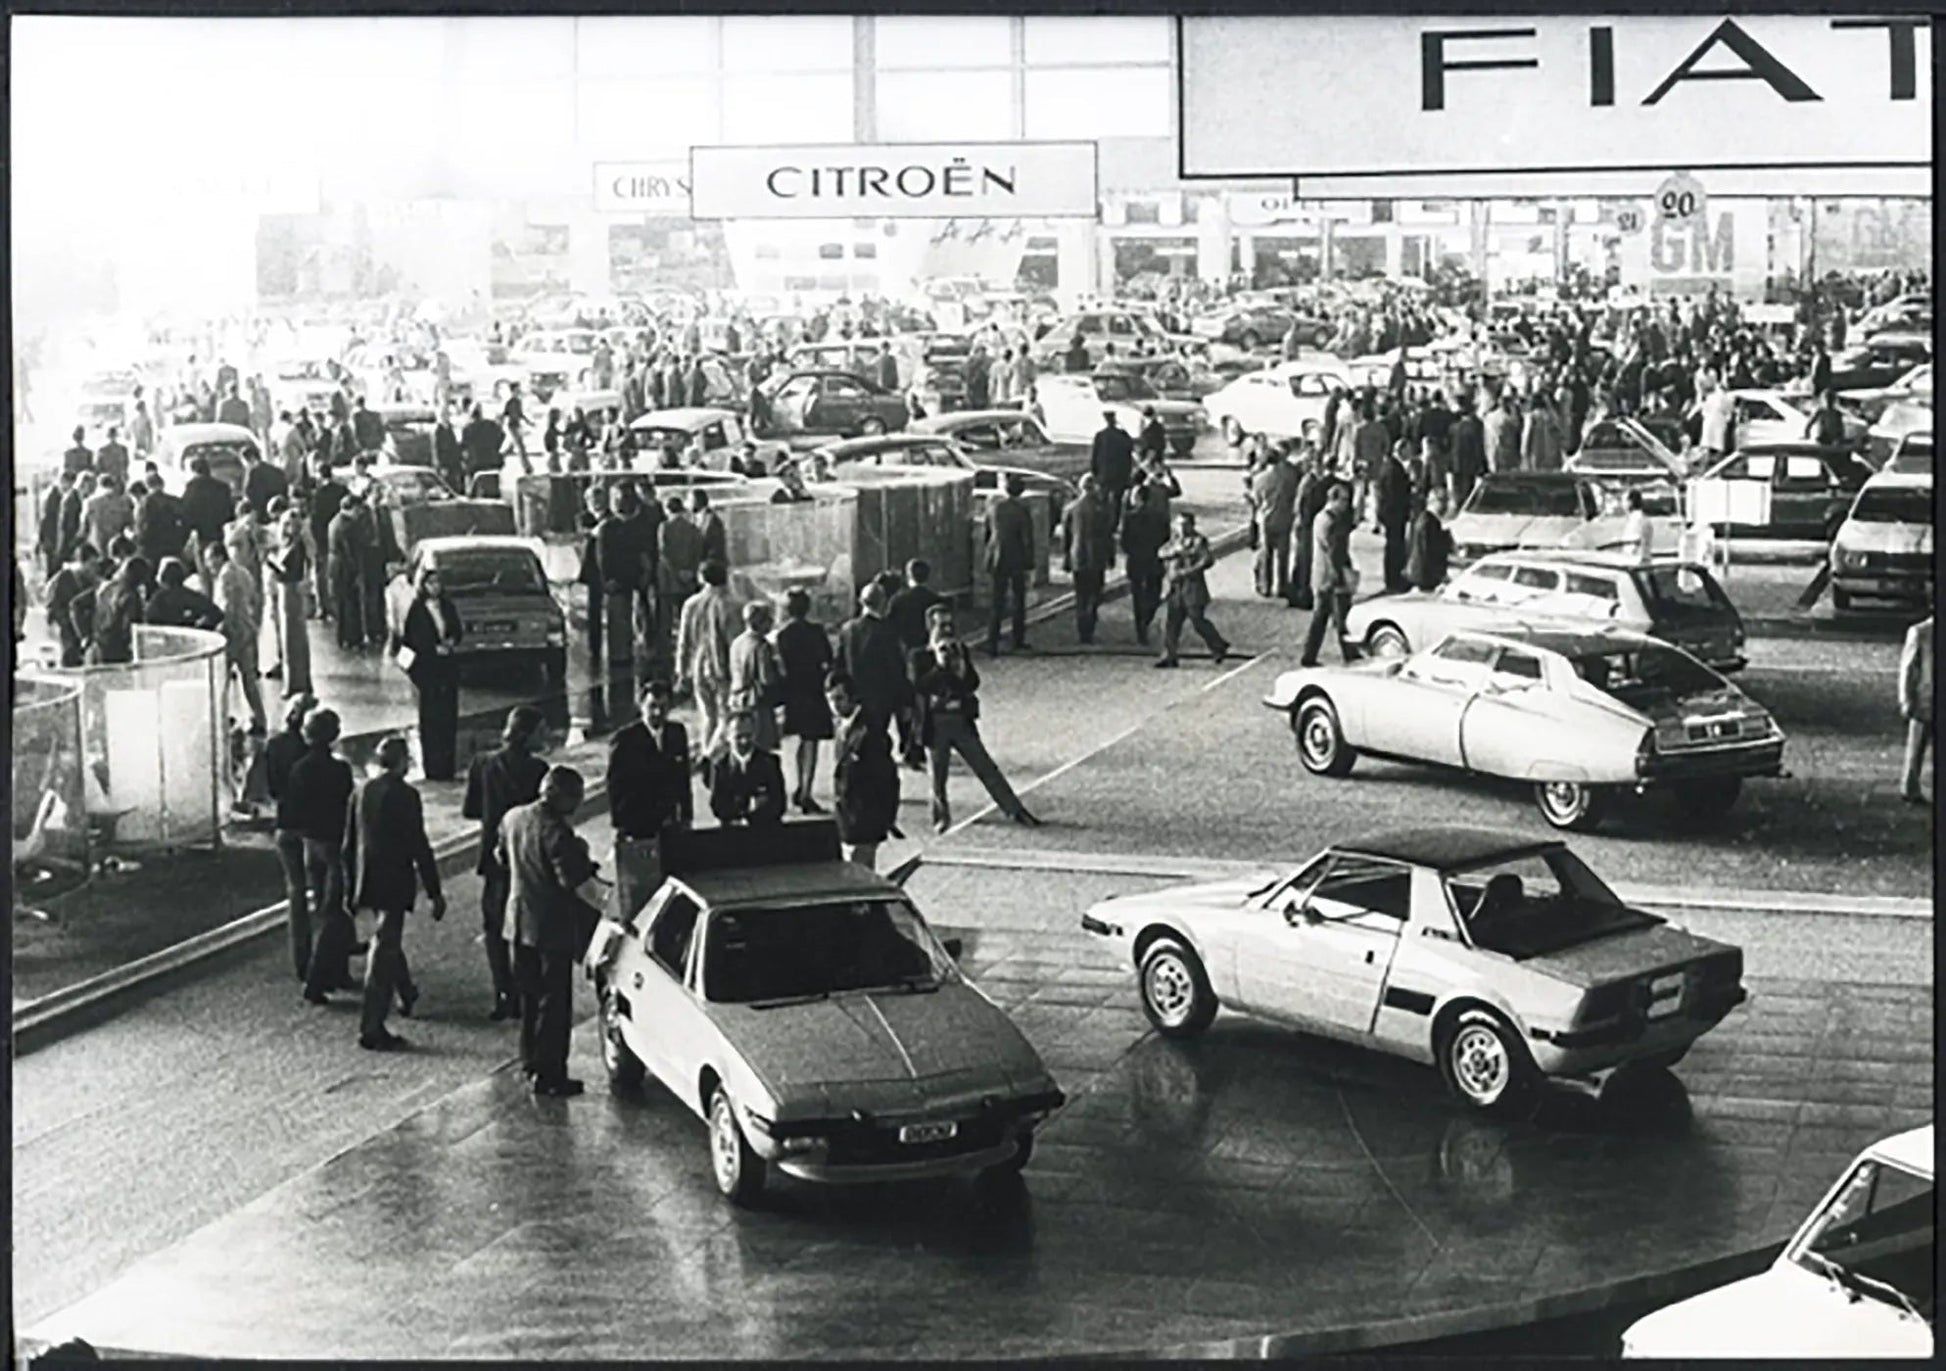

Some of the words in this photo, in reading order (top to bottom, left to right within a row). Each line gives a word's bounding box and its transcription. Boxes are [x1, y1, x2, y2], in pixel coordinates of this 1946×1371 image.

[1421, 17, 1930, 111] FIAT
[767, 157, 1016, 198] CITROËN
[1661, 191, 1695, 219] 20
[1651, 212, 1734, 273] GM
